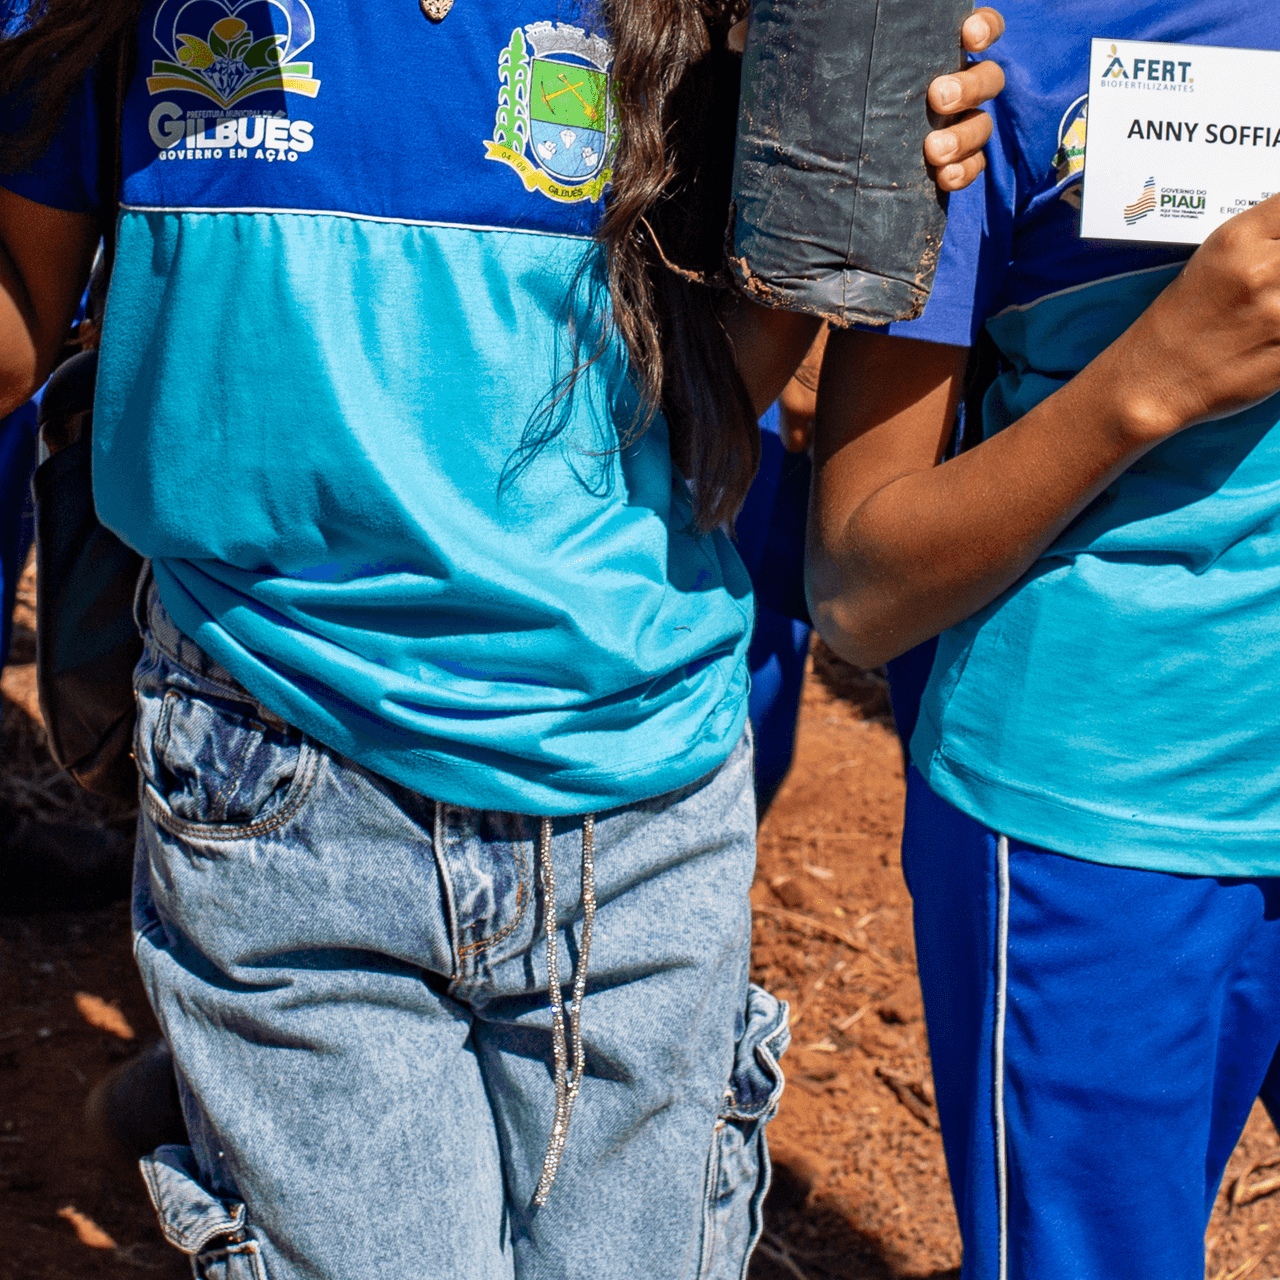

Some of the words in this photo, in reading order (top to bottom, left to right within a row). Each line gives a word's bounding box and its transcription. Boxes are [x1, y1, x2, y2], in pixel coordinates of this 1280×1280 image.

[1100, 79, 1195, 93] BIOFERTILIZANTES
[148, 101, 315, 153] GILBUÉS
[1127, 119, 1199, 143] ANNY
[158, 148, 223, 161] GOVERNO
[229, 148, 248, 159] EM
[254, 147, 299, 163] AÇÃO
[1160, 187, 1195, 195] GOVERNO
